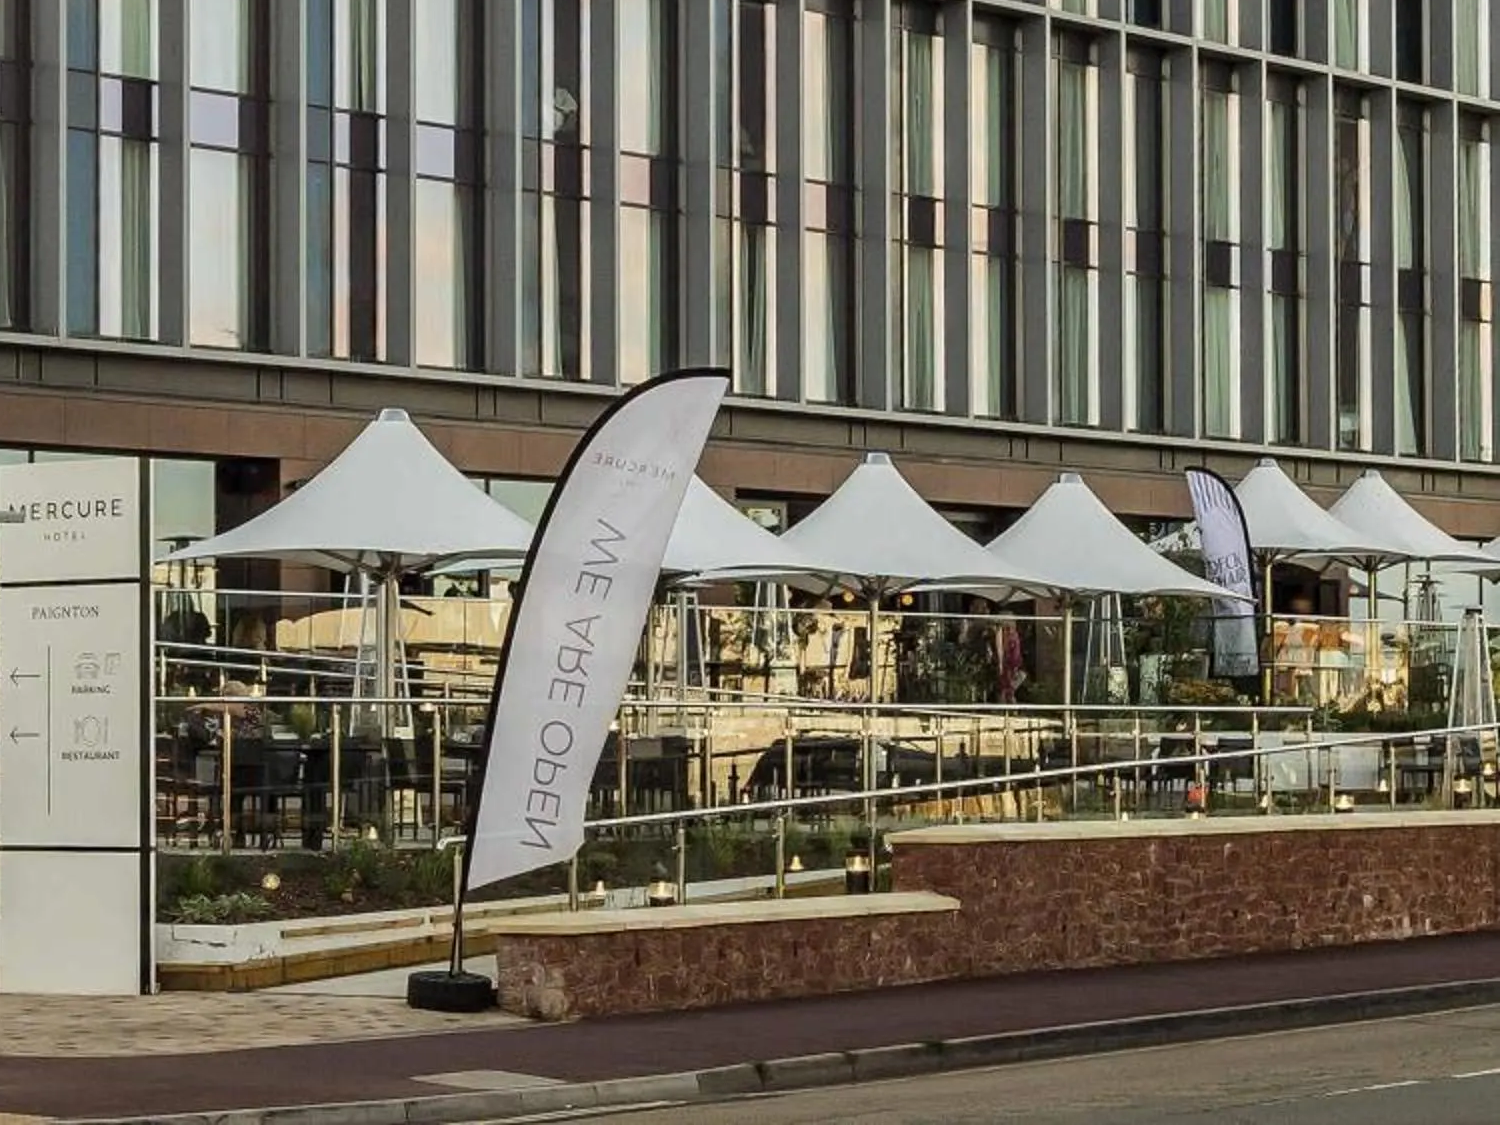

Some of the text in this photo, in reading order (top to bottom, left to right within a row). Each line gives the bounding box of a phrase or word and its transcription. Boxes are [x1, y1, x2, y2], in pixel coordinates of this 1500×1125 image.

[43, 530, 87, 542] HOTEL
[31, 606, 100, 620] PAIGNTON
[60, 750, 120, 761] RESTAURANT
